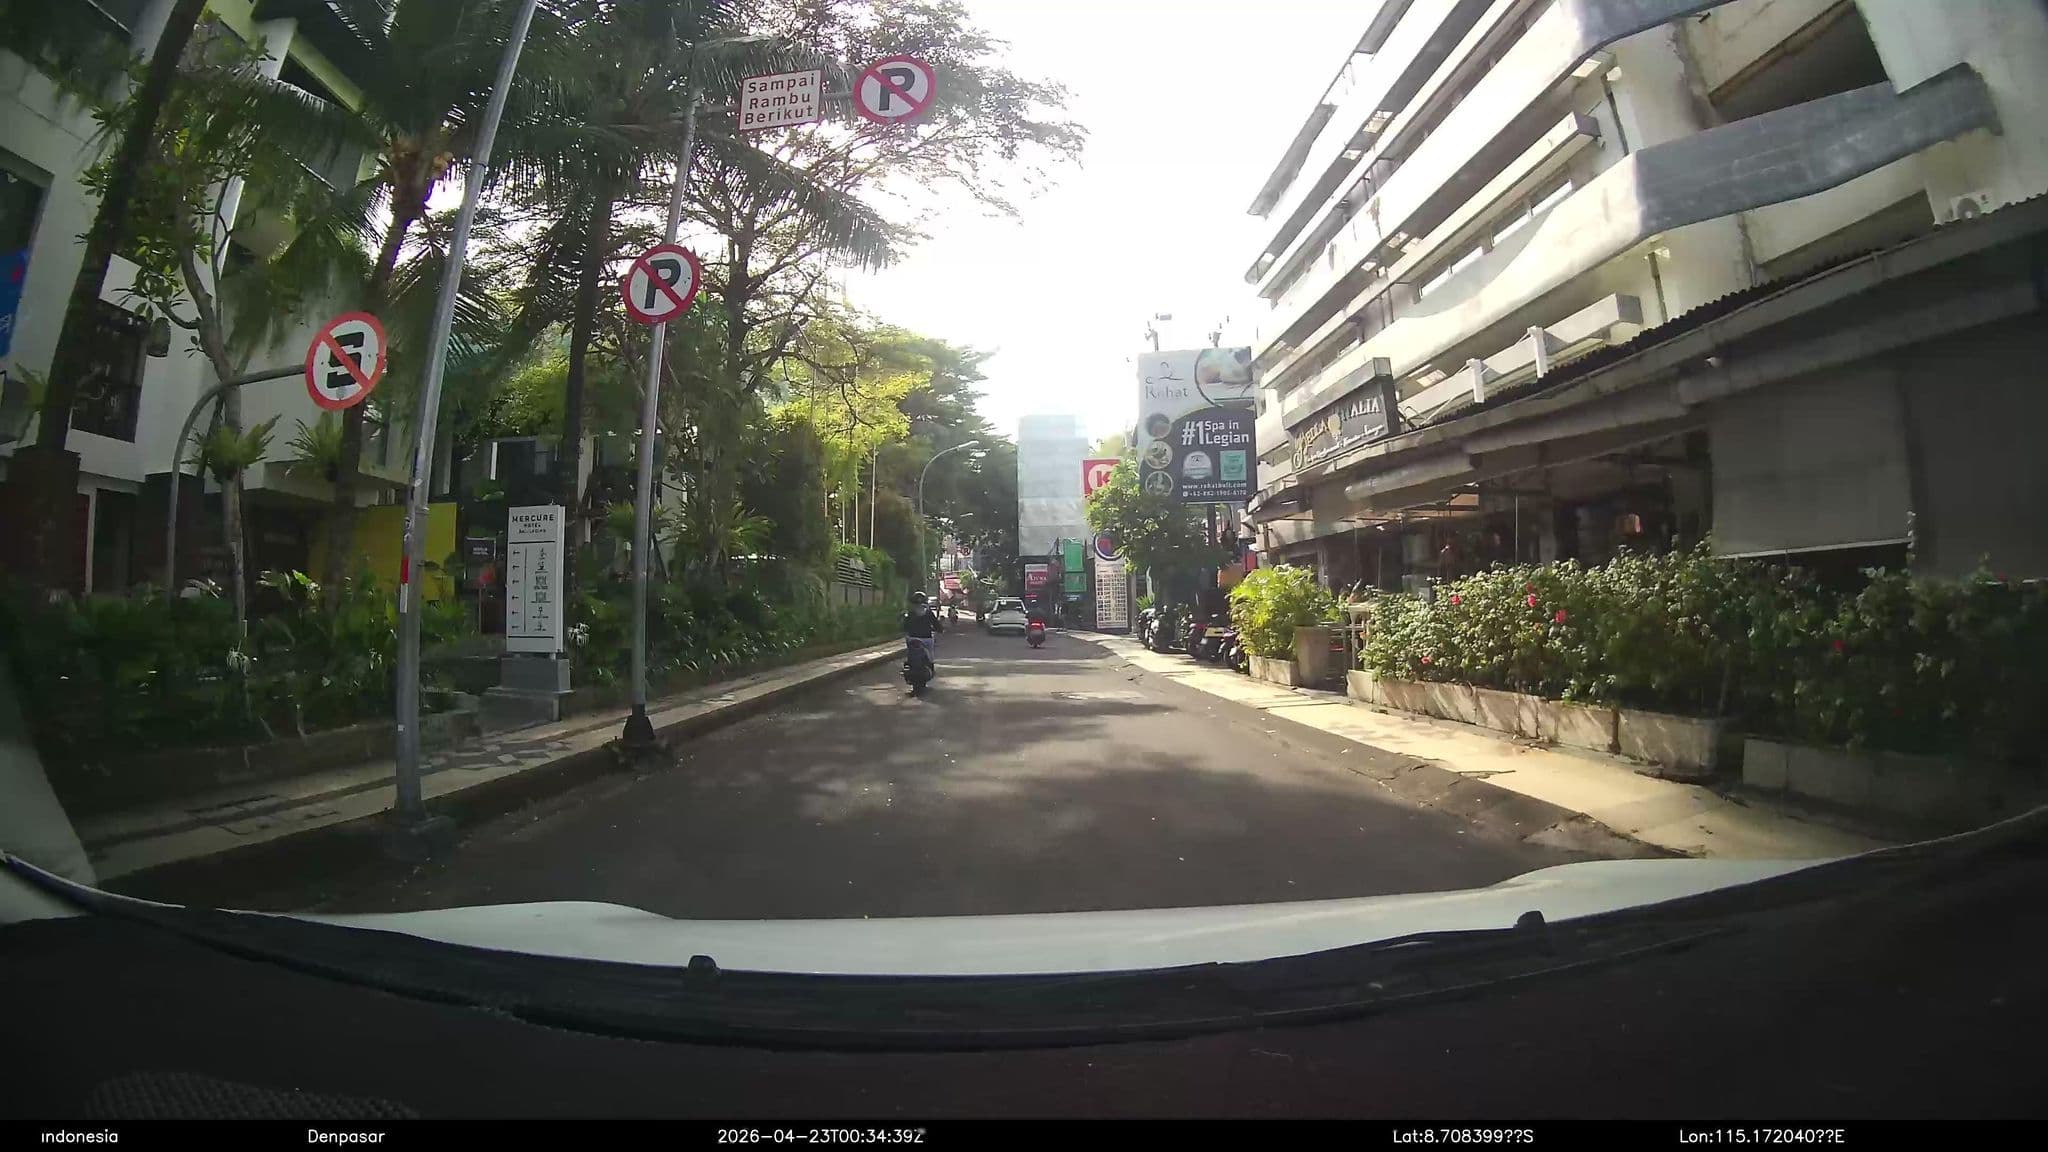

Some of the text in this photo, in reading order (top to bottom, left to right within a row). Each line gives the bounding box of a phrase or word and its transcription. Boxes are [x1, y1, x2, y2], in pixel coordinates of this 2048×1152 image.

[747, 73, 815, 93] Sampai
[749, 91, 811, 110] Rambu
[744, 106, 813, 125] Berikut
[1181, 421, 1204, 445] #1
[1204, 420, 1225, 432] Spa
[1205, 431, 1249, 447] Legian
[511, 514, 555, 523] MERCURE
